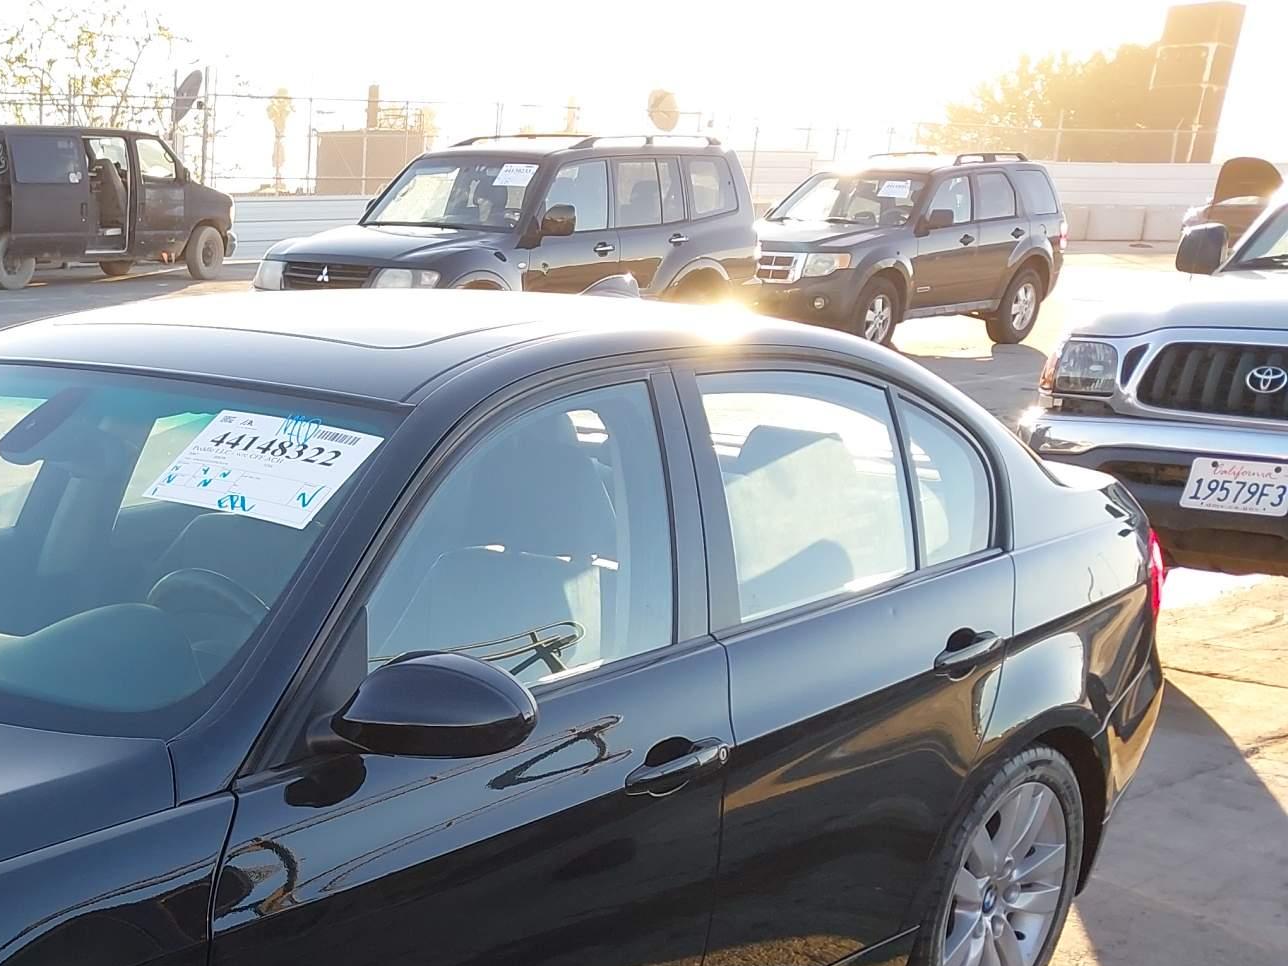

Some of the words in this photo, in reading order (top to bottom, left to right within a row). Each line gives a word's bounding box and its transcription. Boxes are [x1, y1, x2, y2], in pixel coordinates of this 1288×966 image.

[210, 431, 342, 467] 44148322
[1213, 463, 1278, 480] California
[1189, 478, 1287, 507] 19579F3
